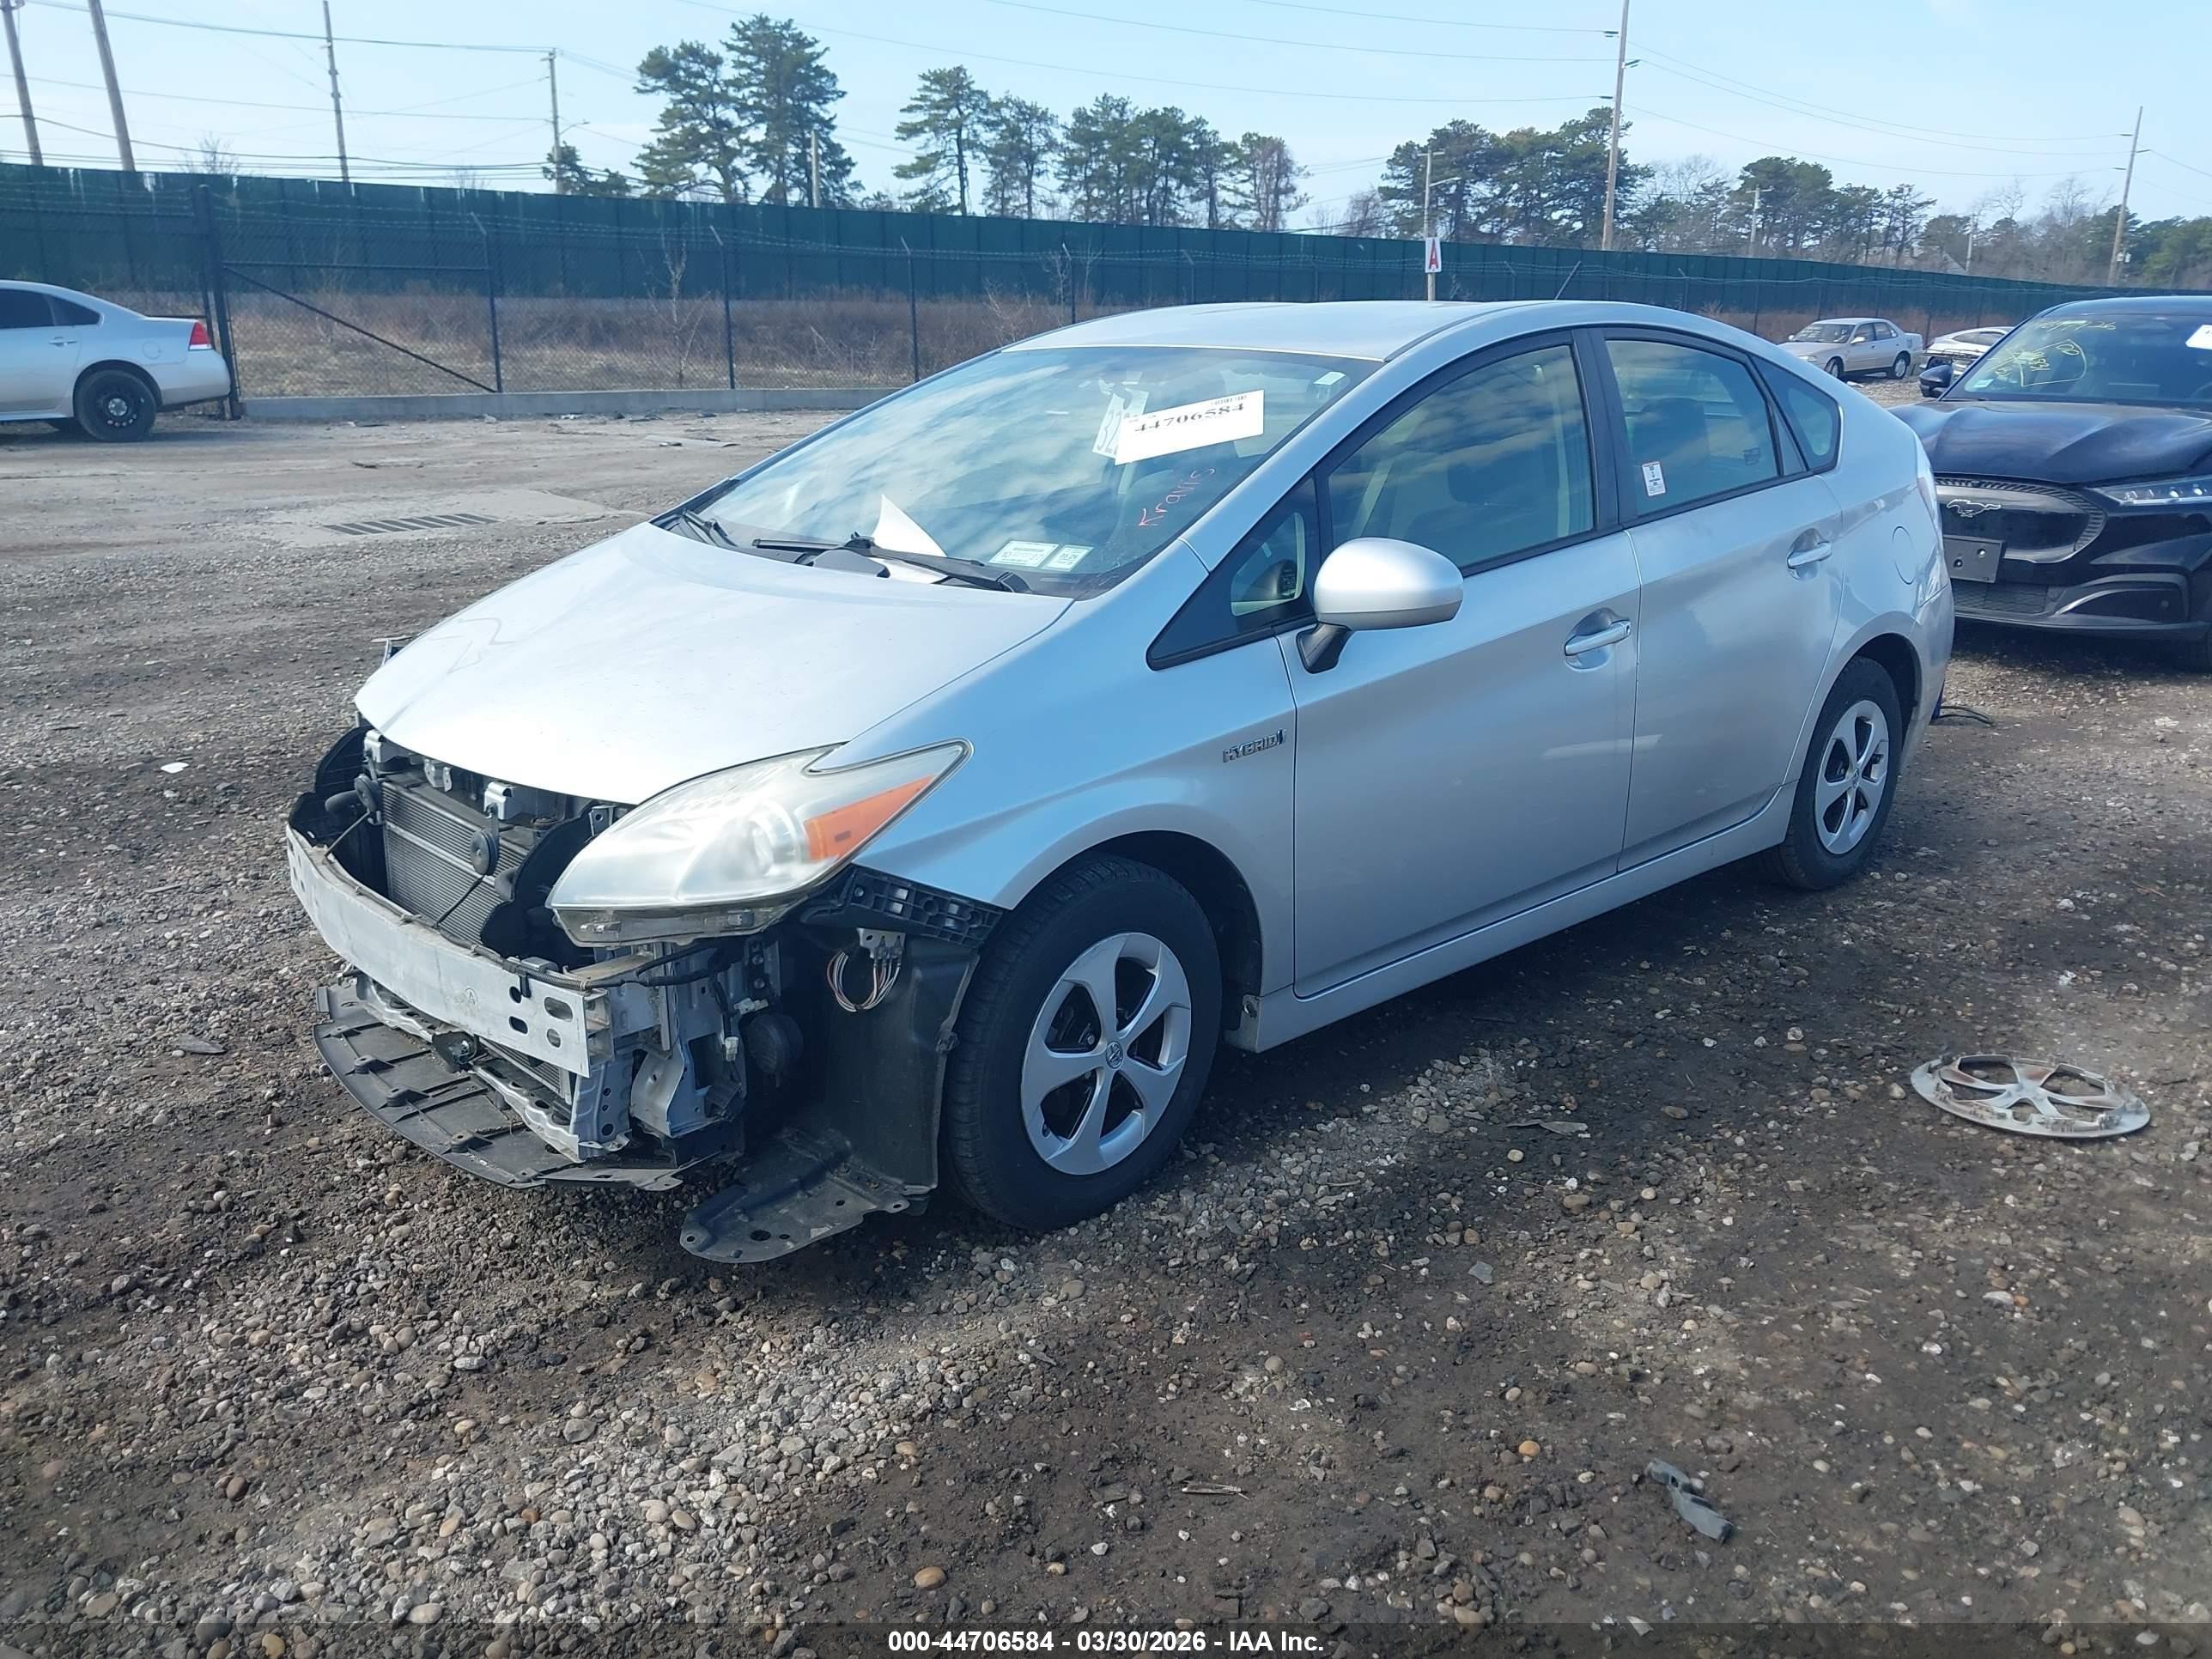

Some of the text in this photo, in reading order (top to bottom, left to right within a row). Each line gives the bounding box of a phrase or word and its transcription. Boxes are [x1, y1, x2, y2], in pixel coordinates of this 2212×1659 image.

[1428, 237, 1439, 270] A
[1133, 402, 1244, 432] 44706584
[1222, 734, 1279, 763] HYBRID
